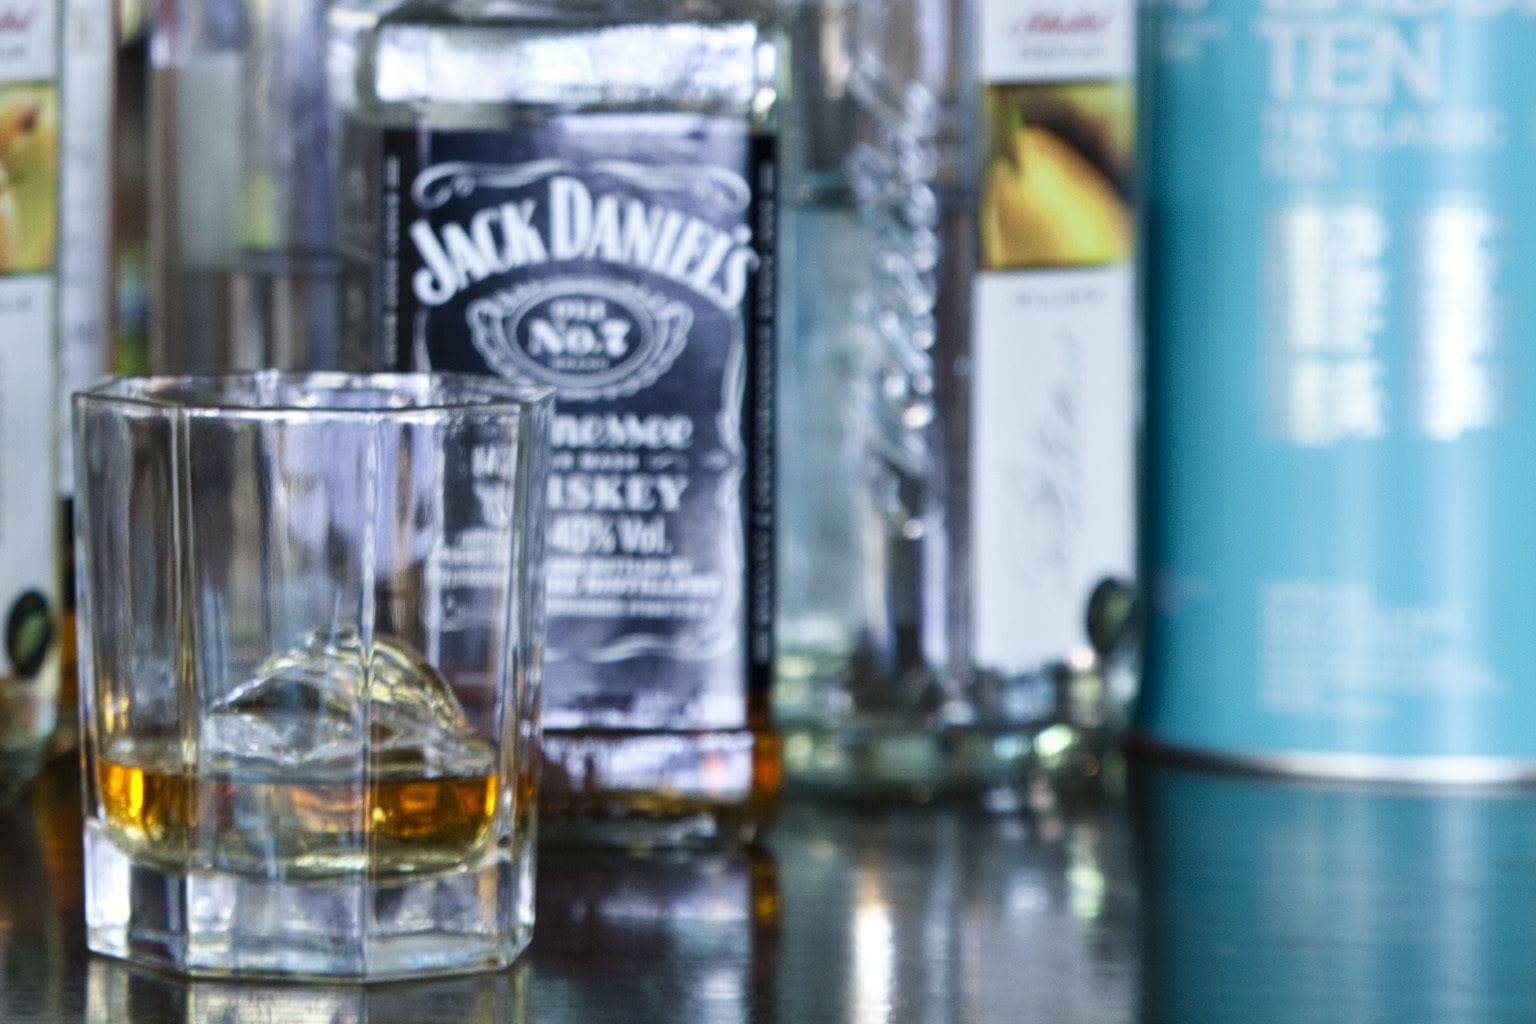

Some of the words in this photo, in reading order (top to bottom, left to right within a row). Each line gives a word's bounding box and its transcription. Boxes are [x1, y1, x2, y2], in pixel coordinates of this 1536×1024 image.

[1252, 16, 1441, 102] TEN
[410, 198, 548, 306] JACK
[547, 175, 759, 311] DANIEL'S
[546, 475, 690, 512] ISKEY
